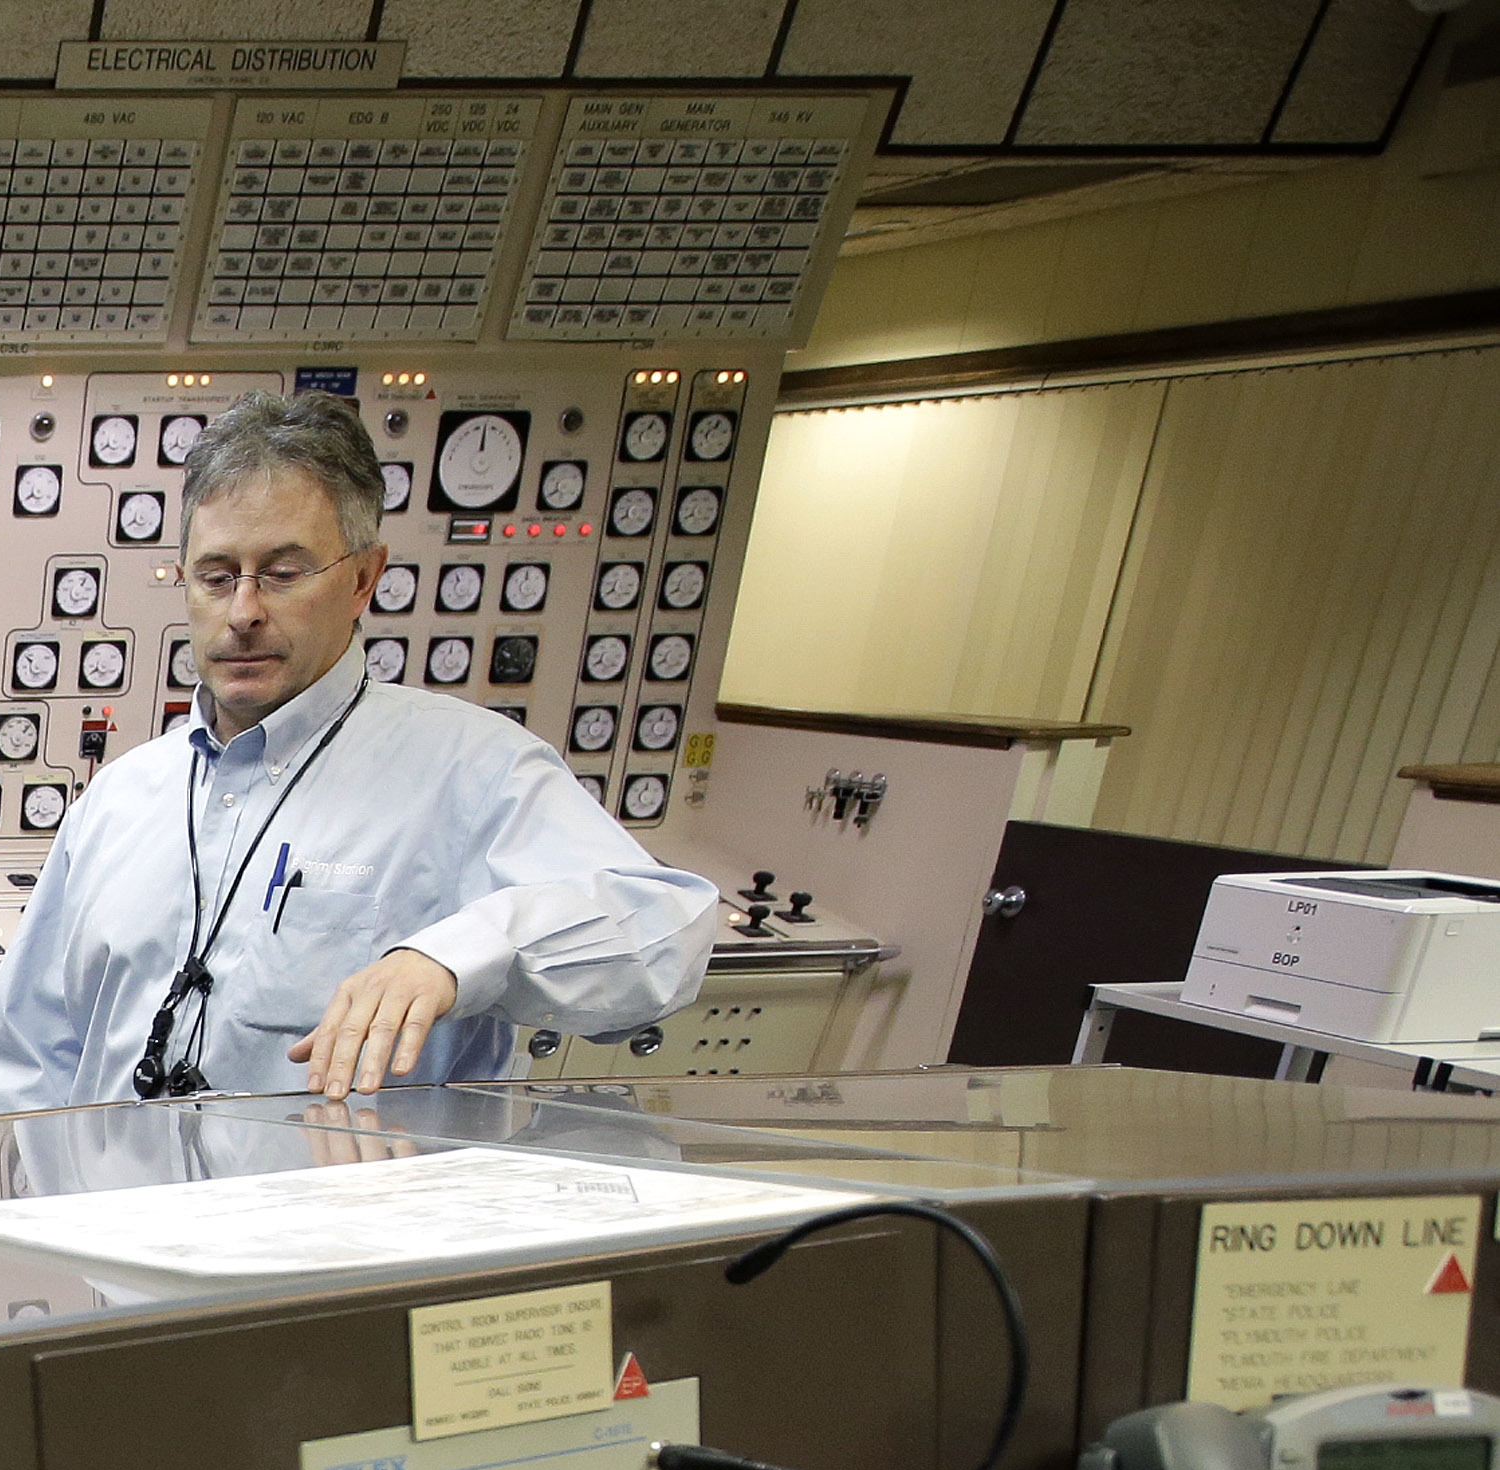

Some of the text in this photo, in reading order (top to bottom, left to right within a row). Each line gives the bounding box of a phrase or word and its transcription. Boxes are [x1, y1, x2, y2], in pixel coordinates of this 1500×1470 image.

[86, 48, 378, 72] ELECTRICAL DISTRIBUTION
[504, 103, 520, 116] 24
[583, 102, 646, 116] MAIN GEN
[685, 102, 717, 116] MAIN
[83, 111, 137, 125] 480 VAC
[256, 111, 305, 125] 120 VAC
[348, 111, 390, 125] EDG B
[796, 111, 814, 124] KV
[426, 120, 450, 133] VDC
[461, 119, 486, 133] VDC
[496, 119, 521, 133] VDC
[578, 119, 639, 133] AUXILIARY
[659, 119, 731, 133] GENERATOR
[689, 734, 715, 749] G G
[1287, 900, 1318, 916] LP01
[1271, 952, 1300, 968] BOP
[1209, 1215, 1467, 1254] RING DOWN LINE
[420, 1318, 463, 1337] CONTROL
[470, 1313, 501, 1329] ROOM
[504, 1303, 563, 1323] SUPERVISOR
